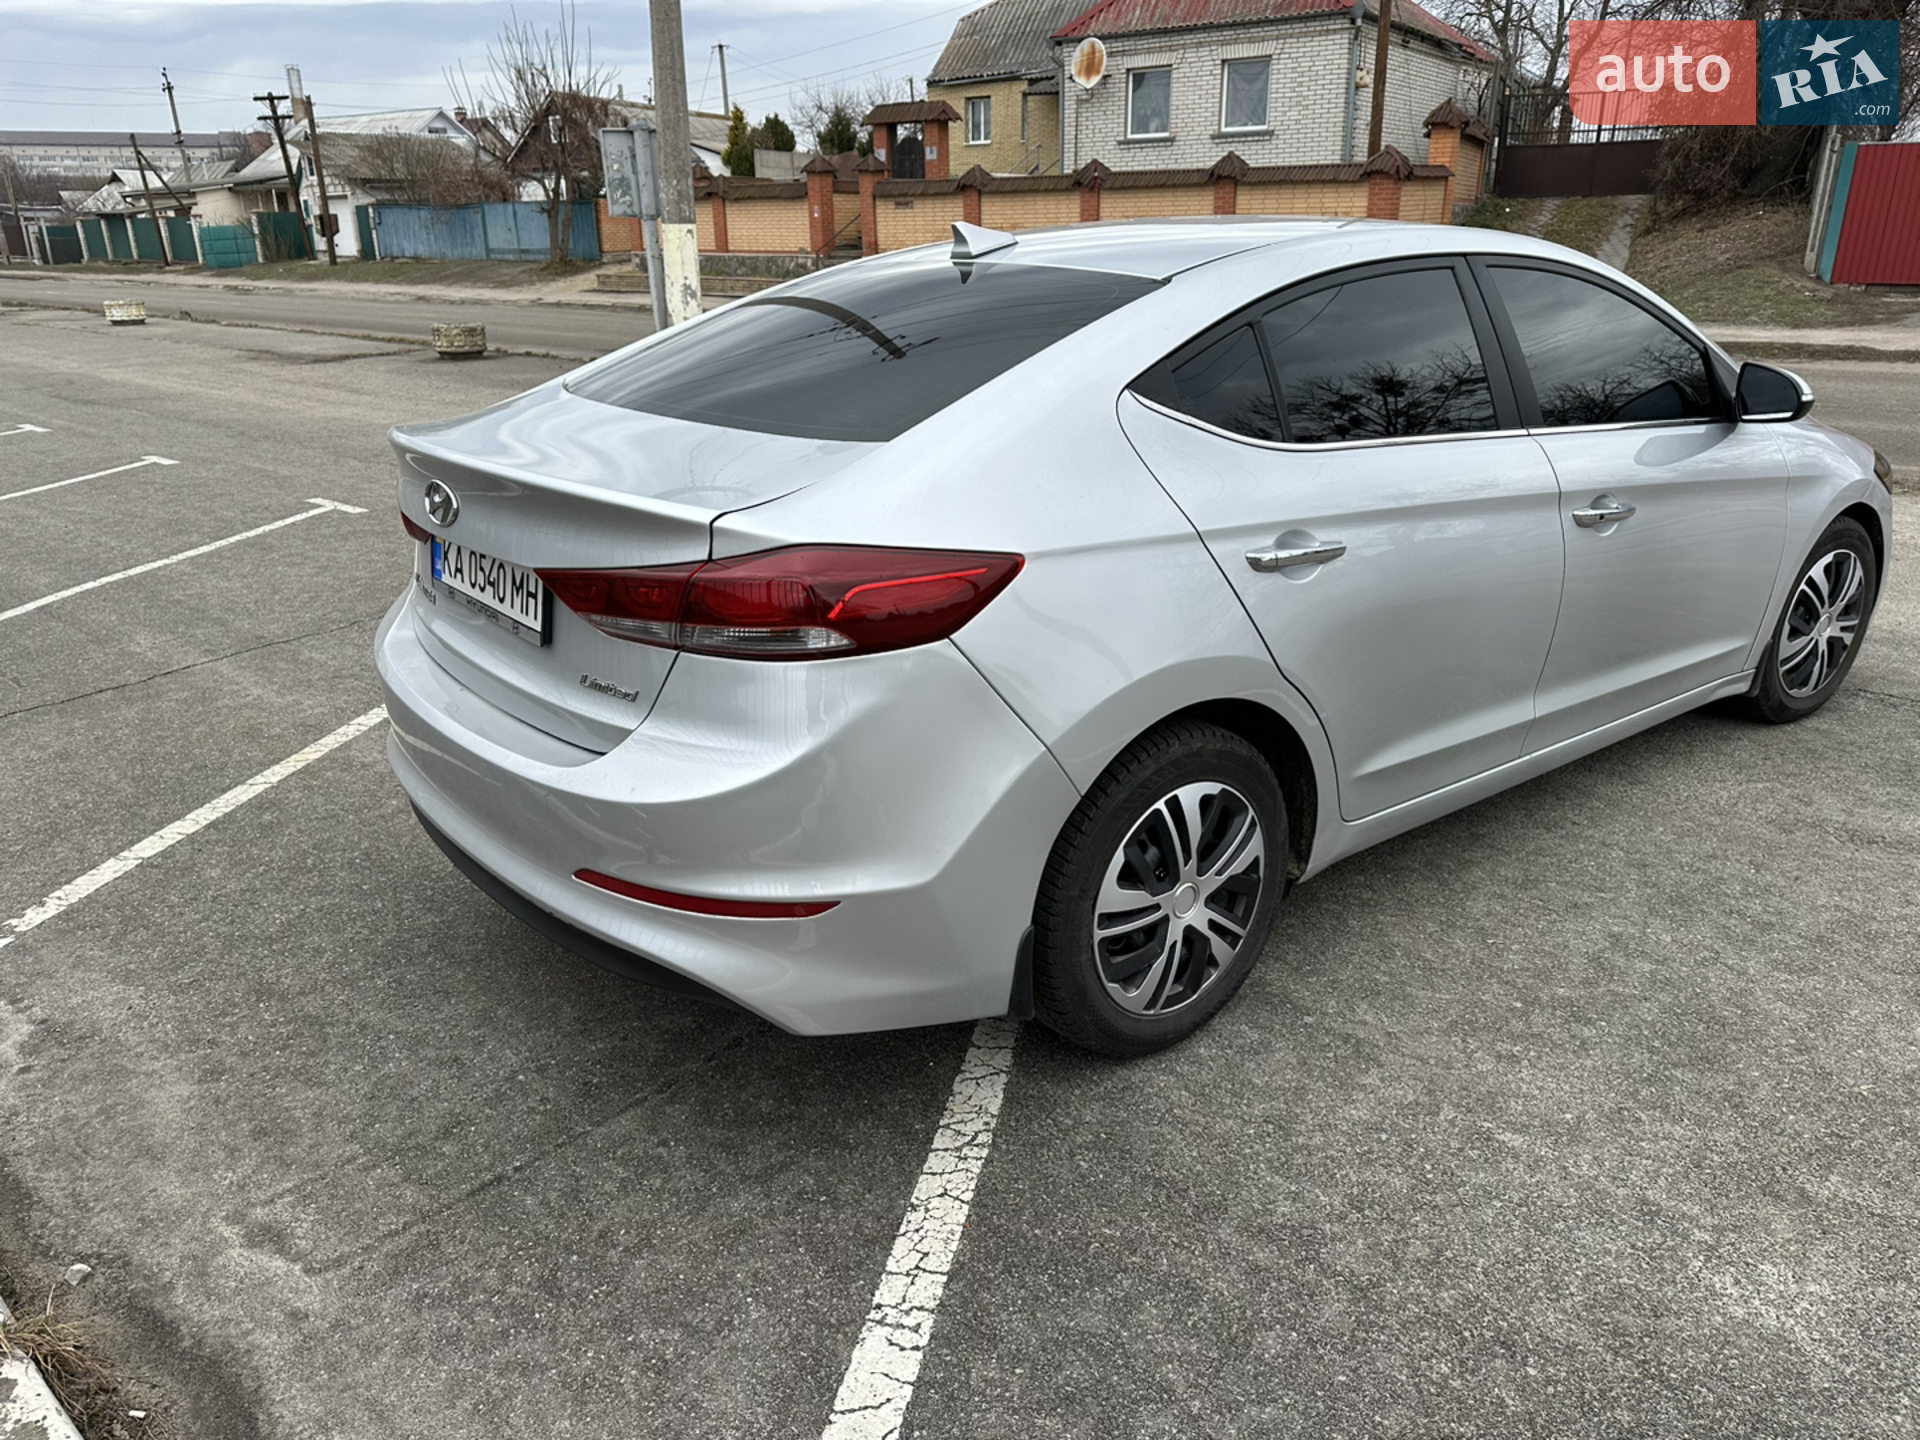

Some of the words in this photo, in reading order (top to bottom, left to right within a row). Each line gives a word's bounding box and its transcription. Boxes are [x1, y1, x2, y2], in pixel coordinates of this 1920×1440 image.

[443, 539, 465, 584] KA
[468, 550, 506, 605] 0540
[510, 566, 538, 621] MH
[579, 672, 640, 703] Limited
